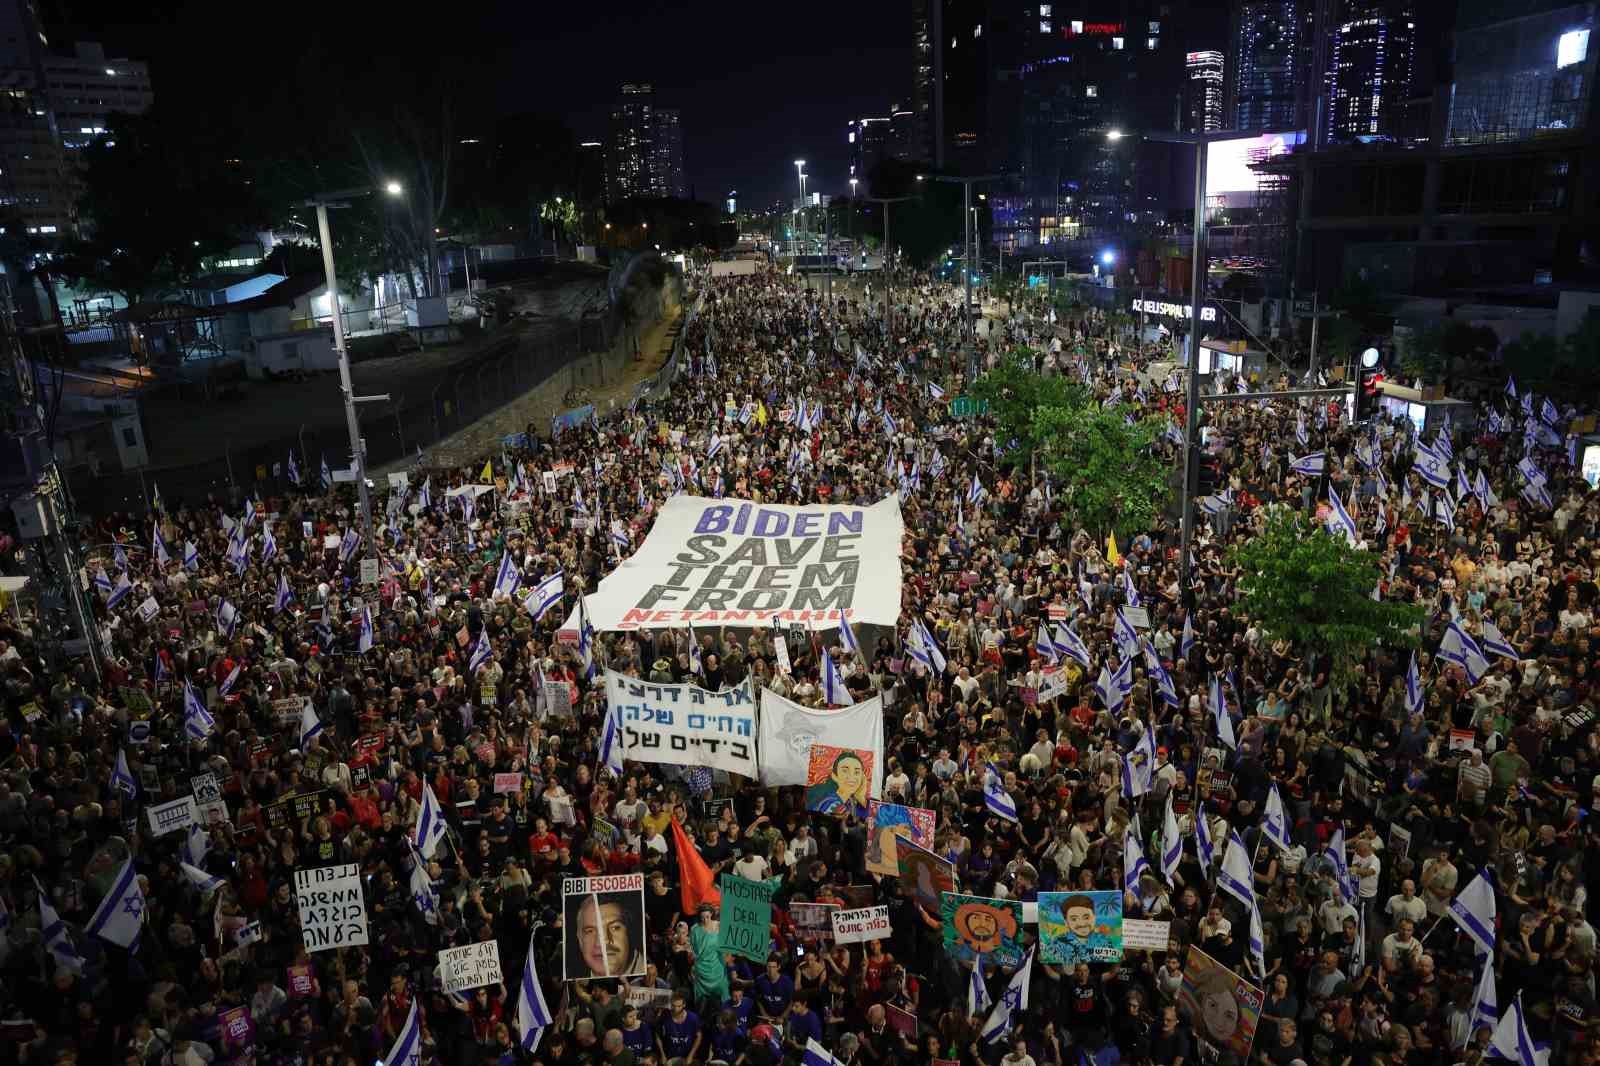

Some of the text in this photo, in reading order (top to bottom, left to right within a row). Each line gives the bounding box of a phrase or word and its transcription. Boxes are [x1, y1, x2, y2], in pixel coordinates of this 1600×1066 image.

[1160, 303, 1184, 317] SPIRAL
[694, 503, 863, 537] BIDEN
[677, 534, 861, 565] SAVE
[667, 560, 860, 589] THEM
[635, 585, 855, 610] FROM
[622, 608, 853, 622] NETANYAHU
[688, 714, 752, 736] החיים
[564, 875, 642, 894] BIBI ESCOBAR
[724, 880, 771, 902] HOSTAGE
[734, 906, 761, 926] DEAL
[725, 924, 765, 956] NOW!
